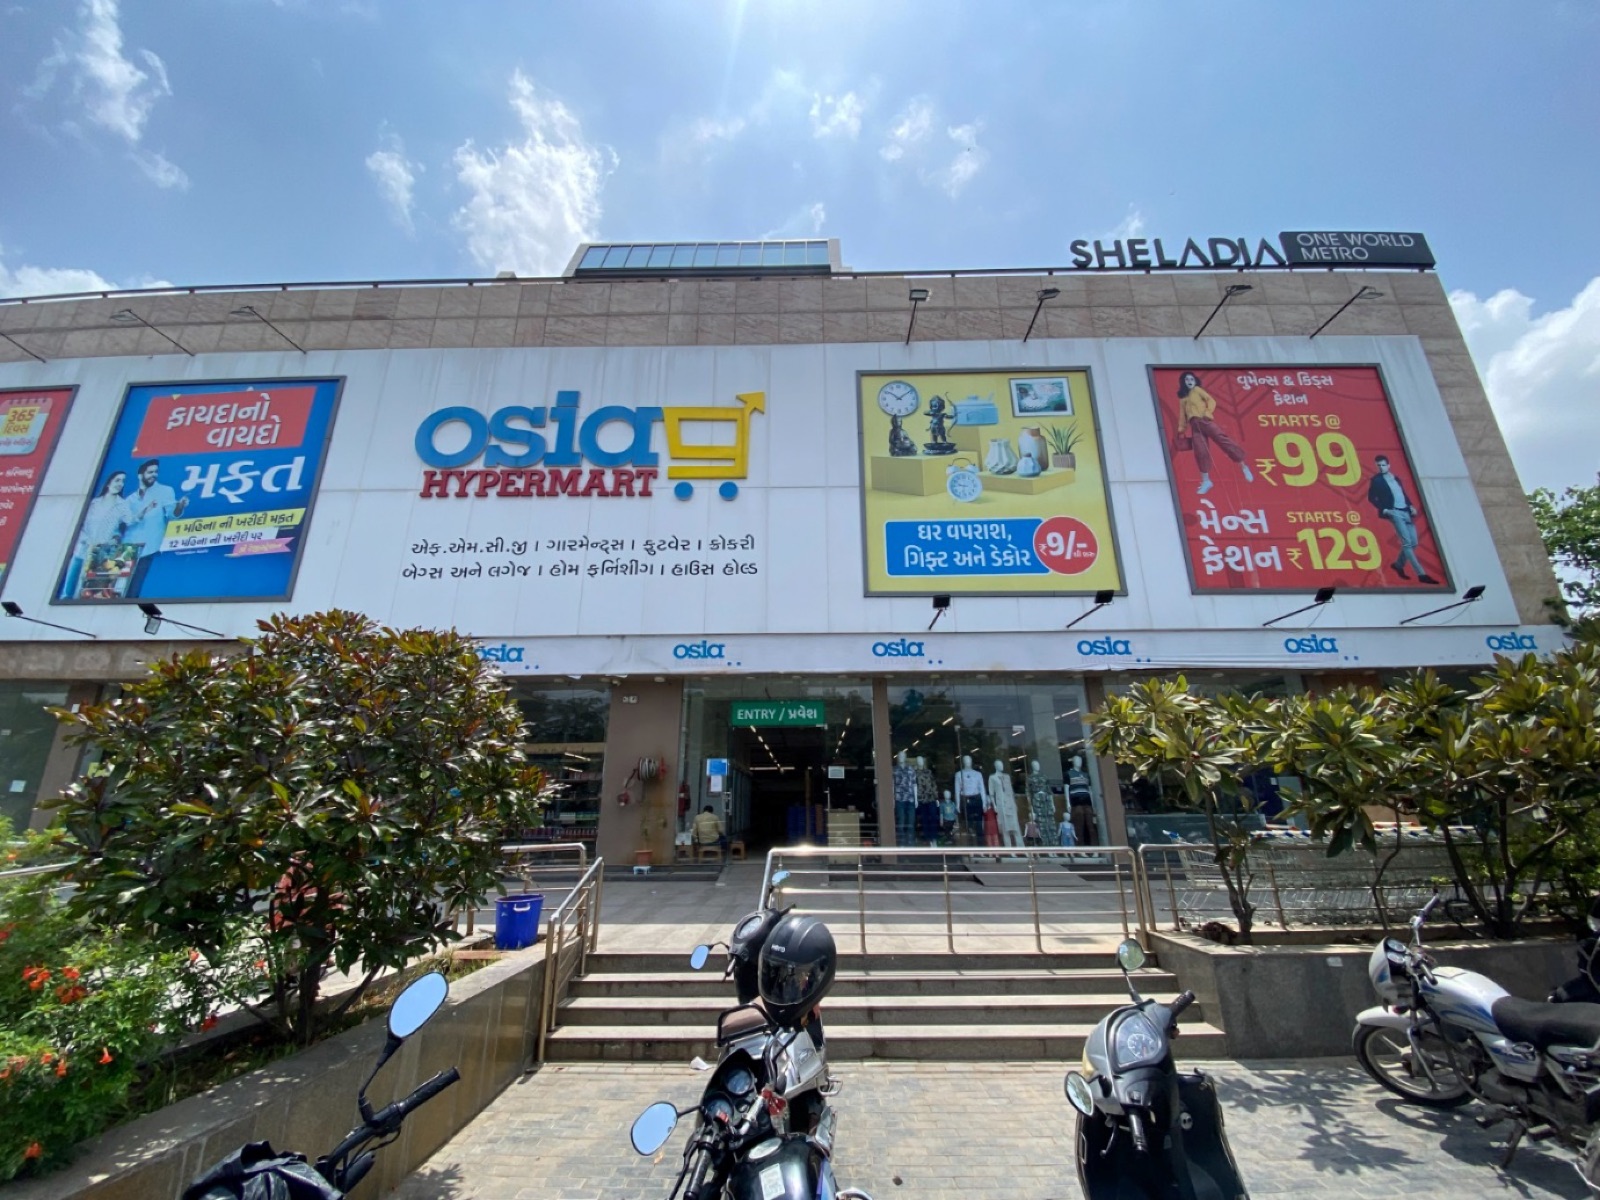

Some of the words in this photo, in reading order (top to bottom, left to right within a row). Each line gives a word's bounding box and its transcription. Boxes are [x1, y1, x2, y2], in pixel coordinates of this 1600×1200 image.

[1297, 233, 1341, 246] ONE
[1344, 233, 1414, 247] WORLD
[1070, 237, 1286, 267] SHELADIA
[1301, 247, 1369, 261] METRO
[1283, 375, 1295, 386] &
[8, 408, 37, 423] 365
[166, 392, 272, 431] ફાયદાનો
[206, 414, 282, 448] વાયદો
[415, 391, 663, 468] osia
[1258, 414, 1322, 427] STARTS
[1325, 414, 1341, 430] @
[180, 455, 307, 504] મફત
[420, 469, 658, 498] HYPERMART
[1196, 498, 1270, 535] મેન્સ
[1286, 511, 1344, 524] STARTS
[1346, 510, 1361, 525] @
[918, 524, 942, 541] ઘર
[953, 544, 987, 568] અને
[989, 543, 1032, 567] ડેકોર
[1199, 535, 1283, 576] ફેશન
[451, 561, 483, 579] અને
[549, 559, 580, 577] હોમ
[671, 559, 715, 577] હાઉસ
[673, 640, 726, 659] osia
[872, 638, 925, 657] osia
[1077, 635, 1133, 655] osia
[1284, 634, 1339, 653] osia
[1486, 631, 1538, 650] osia
[737, 708, 777, 720] ENTRY
